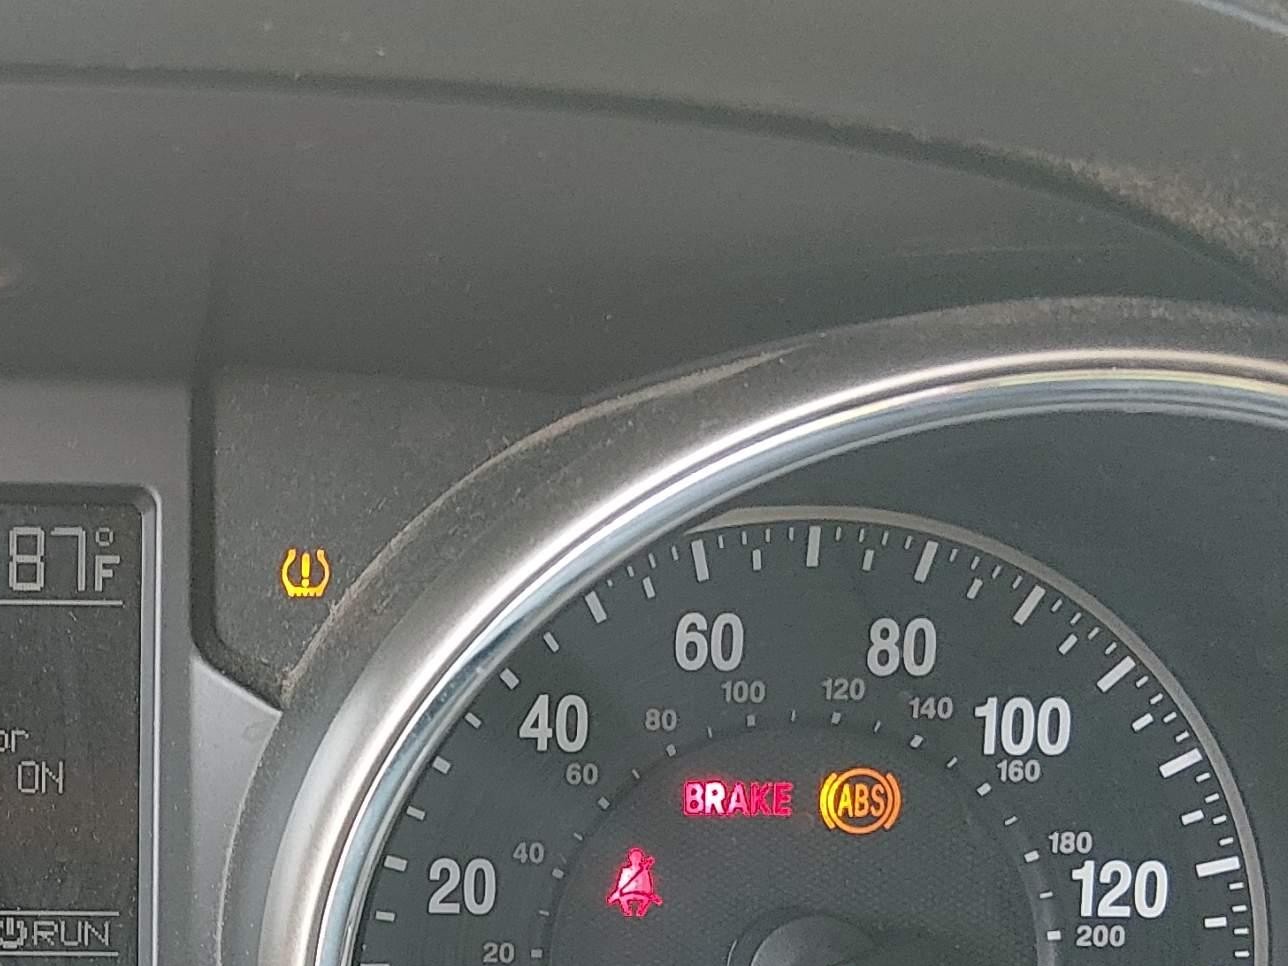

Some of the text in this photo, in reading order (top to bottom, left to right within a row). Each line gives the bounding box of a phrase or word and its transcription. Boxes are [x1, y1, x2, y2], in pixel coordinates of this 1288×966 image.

[674, 612, 744, 672] 60
[866, 617, 937, 677] 80
[720, 681, 766, 703] 100
[822, 678, 865, 701] 120
[644, 708, 677, 732] 80
[909, 697, 953, 720] 140
[518, 694, 589, 753] 40
[973, 696, 1071, 756] 100
[16, 761, 64, 794] ON
[565, 763, 599, 785] 60
[996, 760, 1041, 782] 160
[683, 781, 794, 817] BRAKE
[837, 783, 886, 818] ABS
[512, 842, 545, 864] 40
[1048, 831, 1093, 854] 180
[428, 857, 497, 916] 20
[1071, 860, 1169, 919] 120
[31, 920, 110, 947] RUN
[1076, 925, 1126, 948] 200
[482, 942, 515, 964] 20
